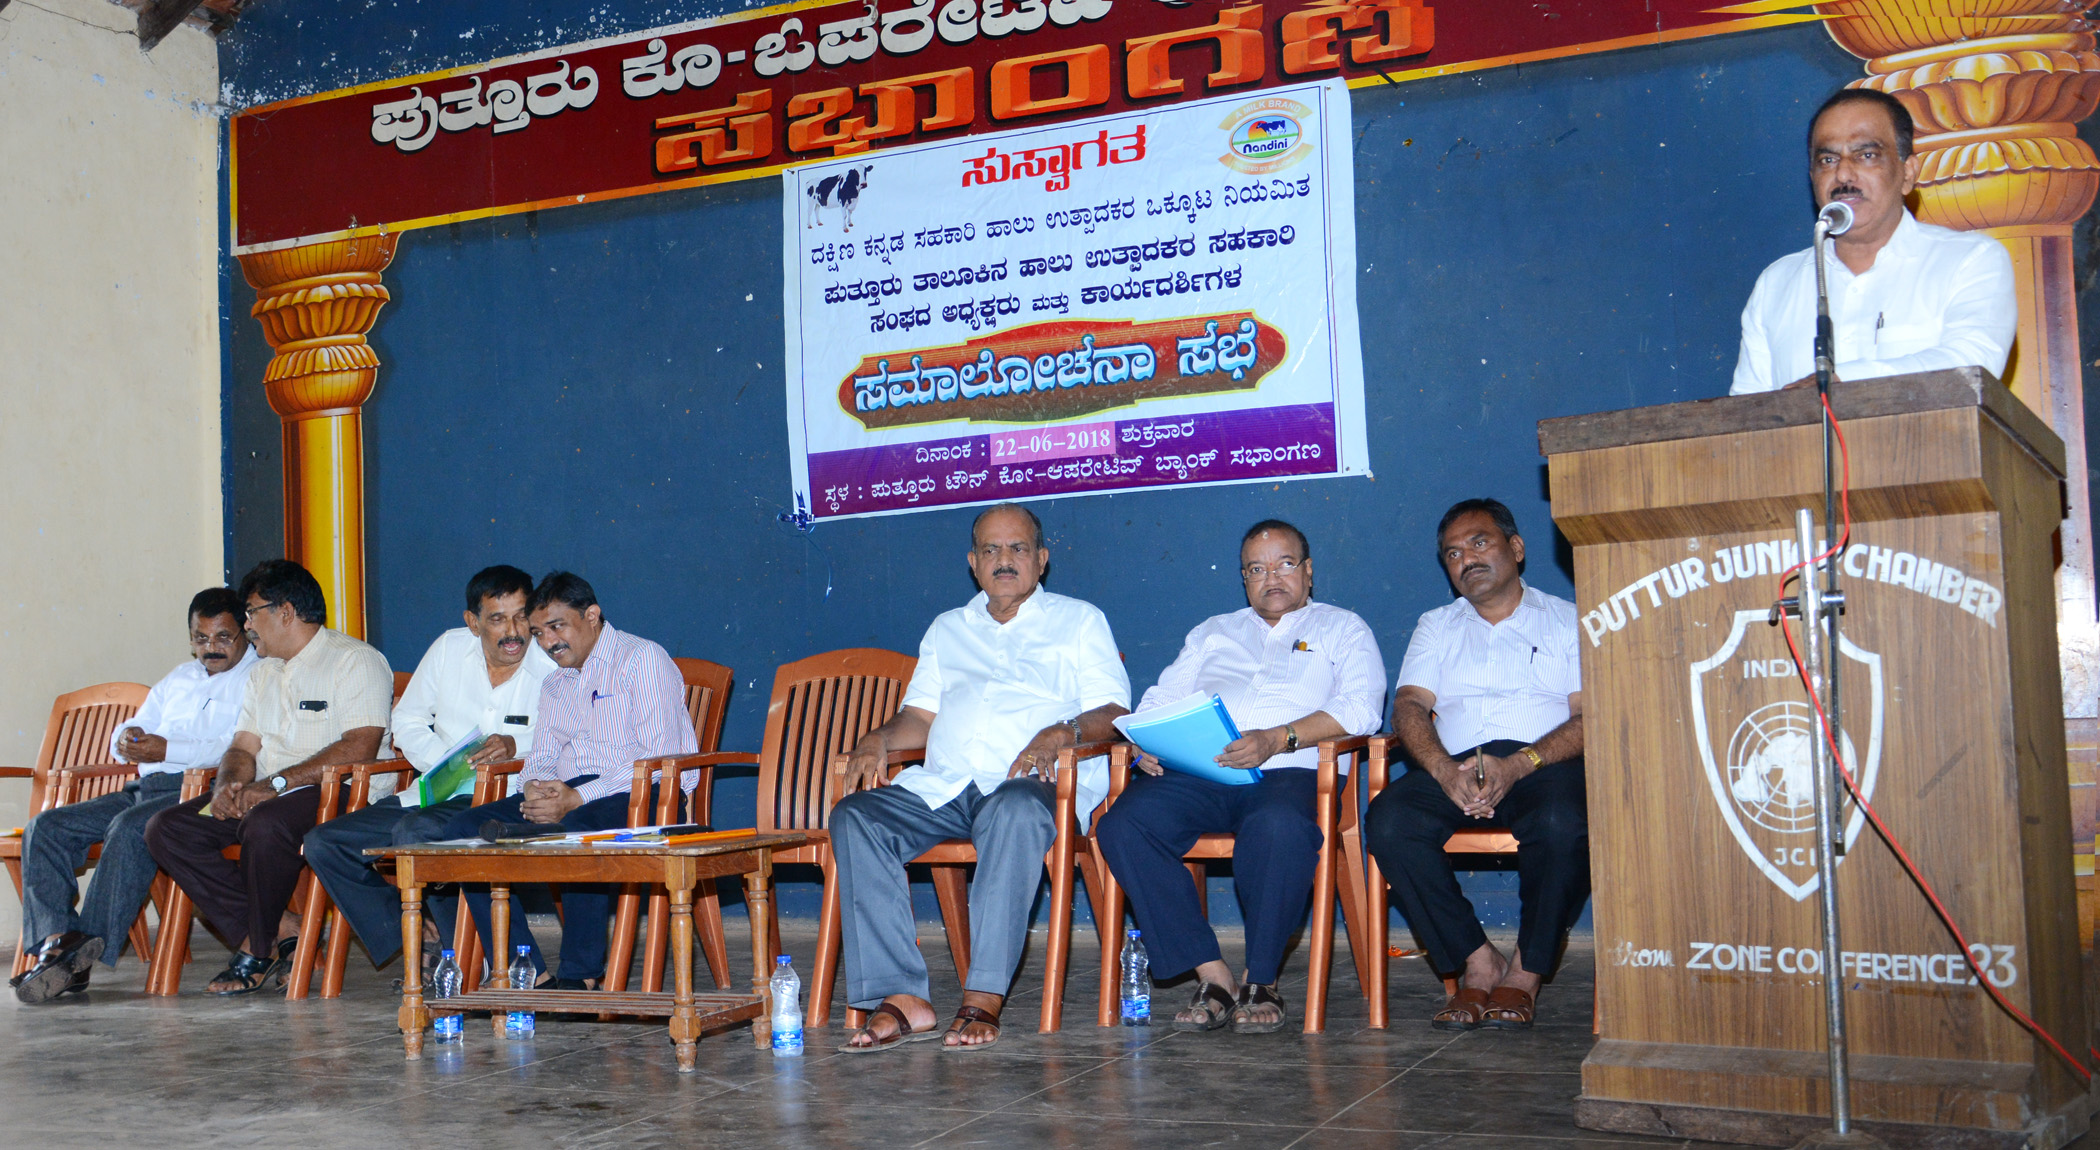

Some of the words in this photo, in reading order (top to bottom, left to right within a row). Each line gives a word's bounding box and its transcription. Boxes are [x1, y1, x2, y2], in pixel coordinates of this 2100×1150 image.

[371, 59, 598, 151] ಪುತ್ತೂರು
[655, 0, 1435, 173] ಸಭಾಂಗಣ
[1243, 100, 1266, 115] MILK
[1268, 100, 1302, 113] BRAND
[962, 124, 1146, 192] ಸುಸ್ವಾಗತ
[811, 241, 855, 272] ದಕ್ಷಿಣ
[864, 229, 905, 265] ಕನ್ನಡ
[914, 222, 976, 249] ಸಹಕಾರಿ
[986, 213, 1035, 239] ಹಾಲು
[1046, 196, 1135, 234] ಉತ್ಪಾದಕರ
[1146, 188, 1212, 224] ಒಕ್ಕೂಟ
[1223, 173, 1311, 207] ನಿಯಮಿತ
[824, 272, 903, 306] ಪುತ್ತೂರು
[913, 256, 1008, 291] ತಾಲೂಕಿನ
[1019, 253, 1073, 278] ಹಾಲು
[1085, 231, 1196, 272] ಉತ್ಪಾದಕರ
[1208, 223, 1296, 254] ಸಹಕಾರಿ
[870, 303, 931, 333] ಸಂಘದ
[942, 291, 1021, 331] ಅಧ್ಯಕ್ಷರು
[1032, 291, 1070, 314] ಮತ್ತು
[1081, 263, 1243, 305] ಕಾರ್ಯದರ್ಶಿಗಳ
[853, 334, 1157, 413] ಸಮಾಲೋಚನಾ
[1176, 318, 1258, 382] ಸಭೆ
[825, 483, 849, 512] ಸ್ಥಳ
[871, 474, 936, 502] ಪುತ್ತೂರು
[945, 469, 989, 490] ಟೌನ್
[1155, 448, 1219, 479] ಬ್ಯಾಂಕ್
[1230, 440, 1321, 467] ಸಭಾಂಗಣ
[916, 440, 972, 464] ದಿನಾಂಕ
[995, 428, 1111, 457] 22-06-2018
[1121, 418, 1195, 448] ಶುಕ್ರವಾರ
[1580, 556, 1711, 648] PUTTUR
[1711, 540, 1841, 583] JUNI
[1844, 543, 2002, 629] CHAMBER
[1743, 658, 1807, 679] INDI
[1686, 942, 1773, 973] ZONE
[1777, 947, 1966, 985] COFERENCE
